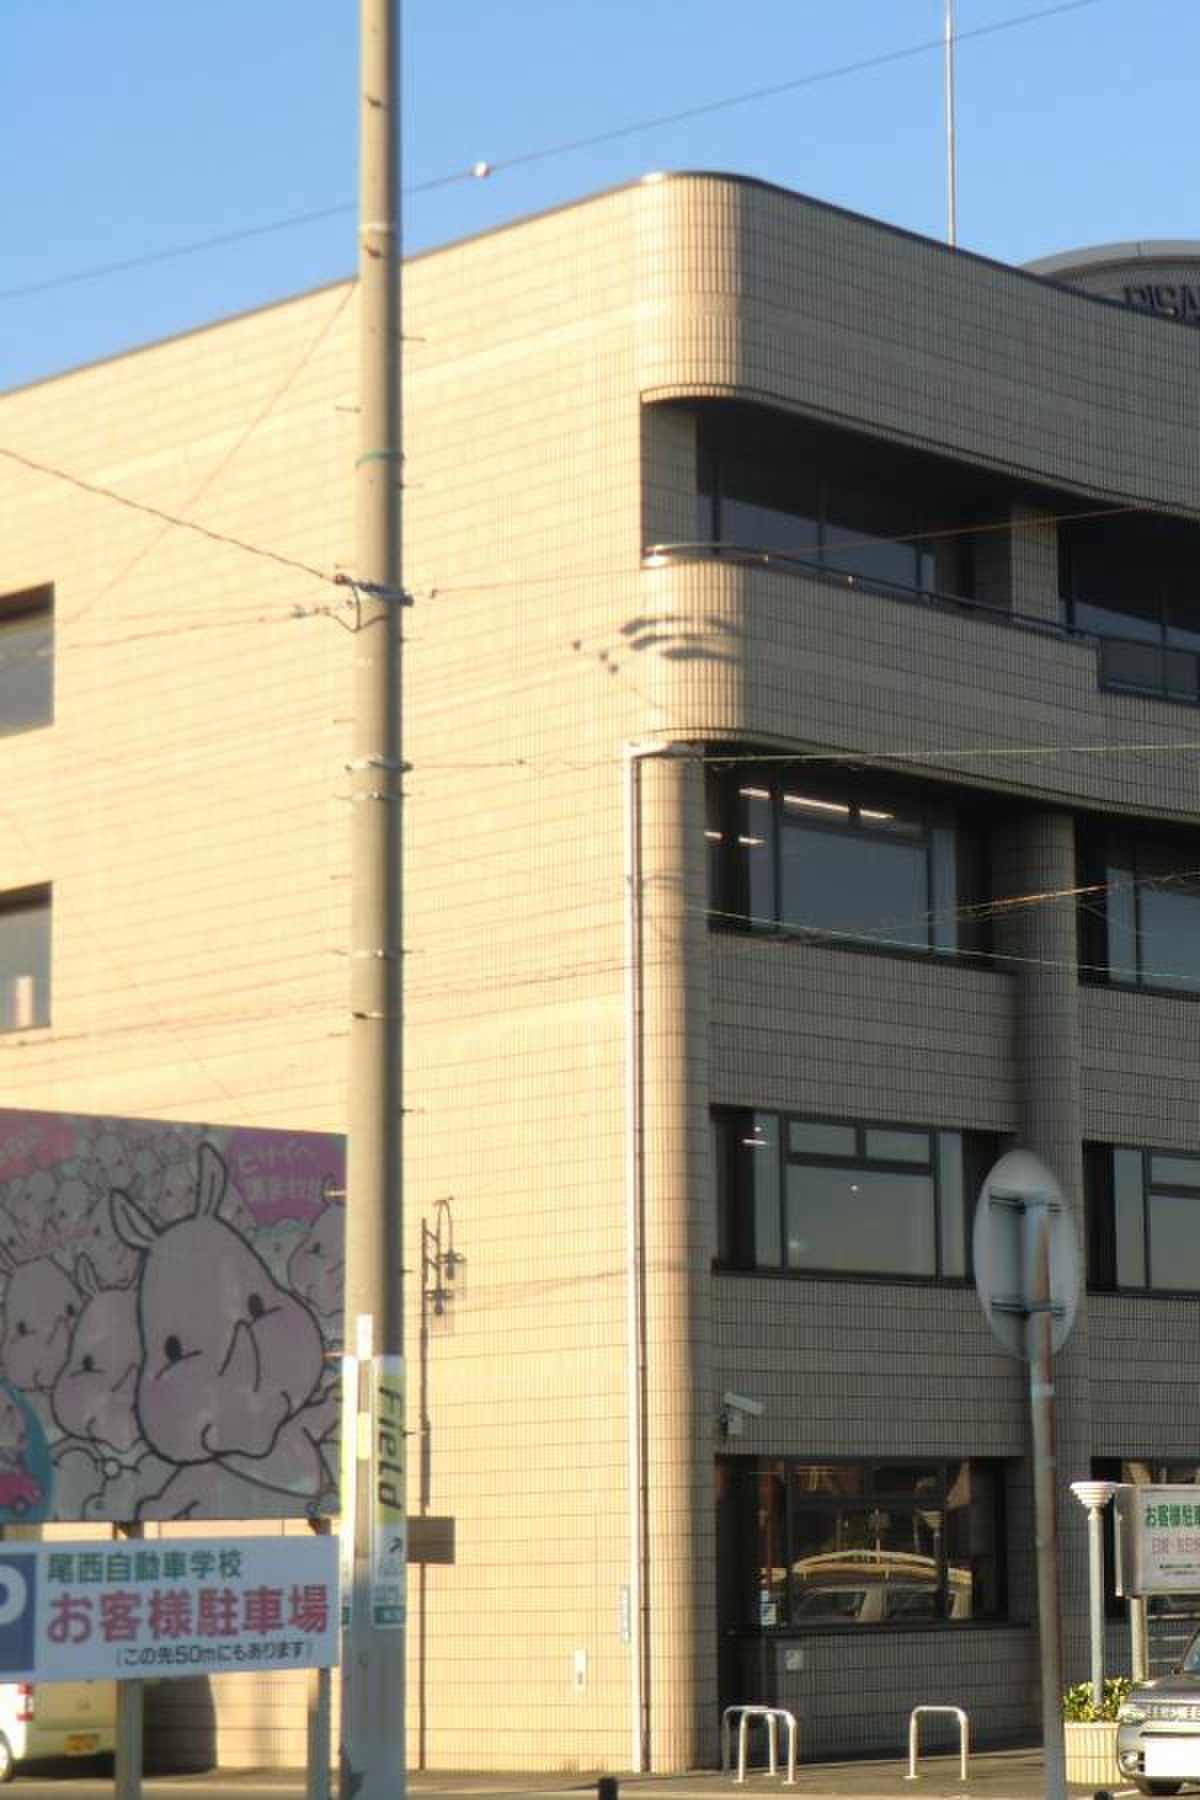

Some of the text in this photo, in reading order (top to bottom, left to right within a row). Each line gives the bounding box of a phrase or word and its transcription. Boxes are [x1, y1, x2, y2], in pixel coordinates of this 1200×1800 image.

[378, 1385, 404, 1510] Field
[47, 1550, 243, 1584] 尾西自動車学校
[46, 1584, 330, 1645] お客様駐車場
